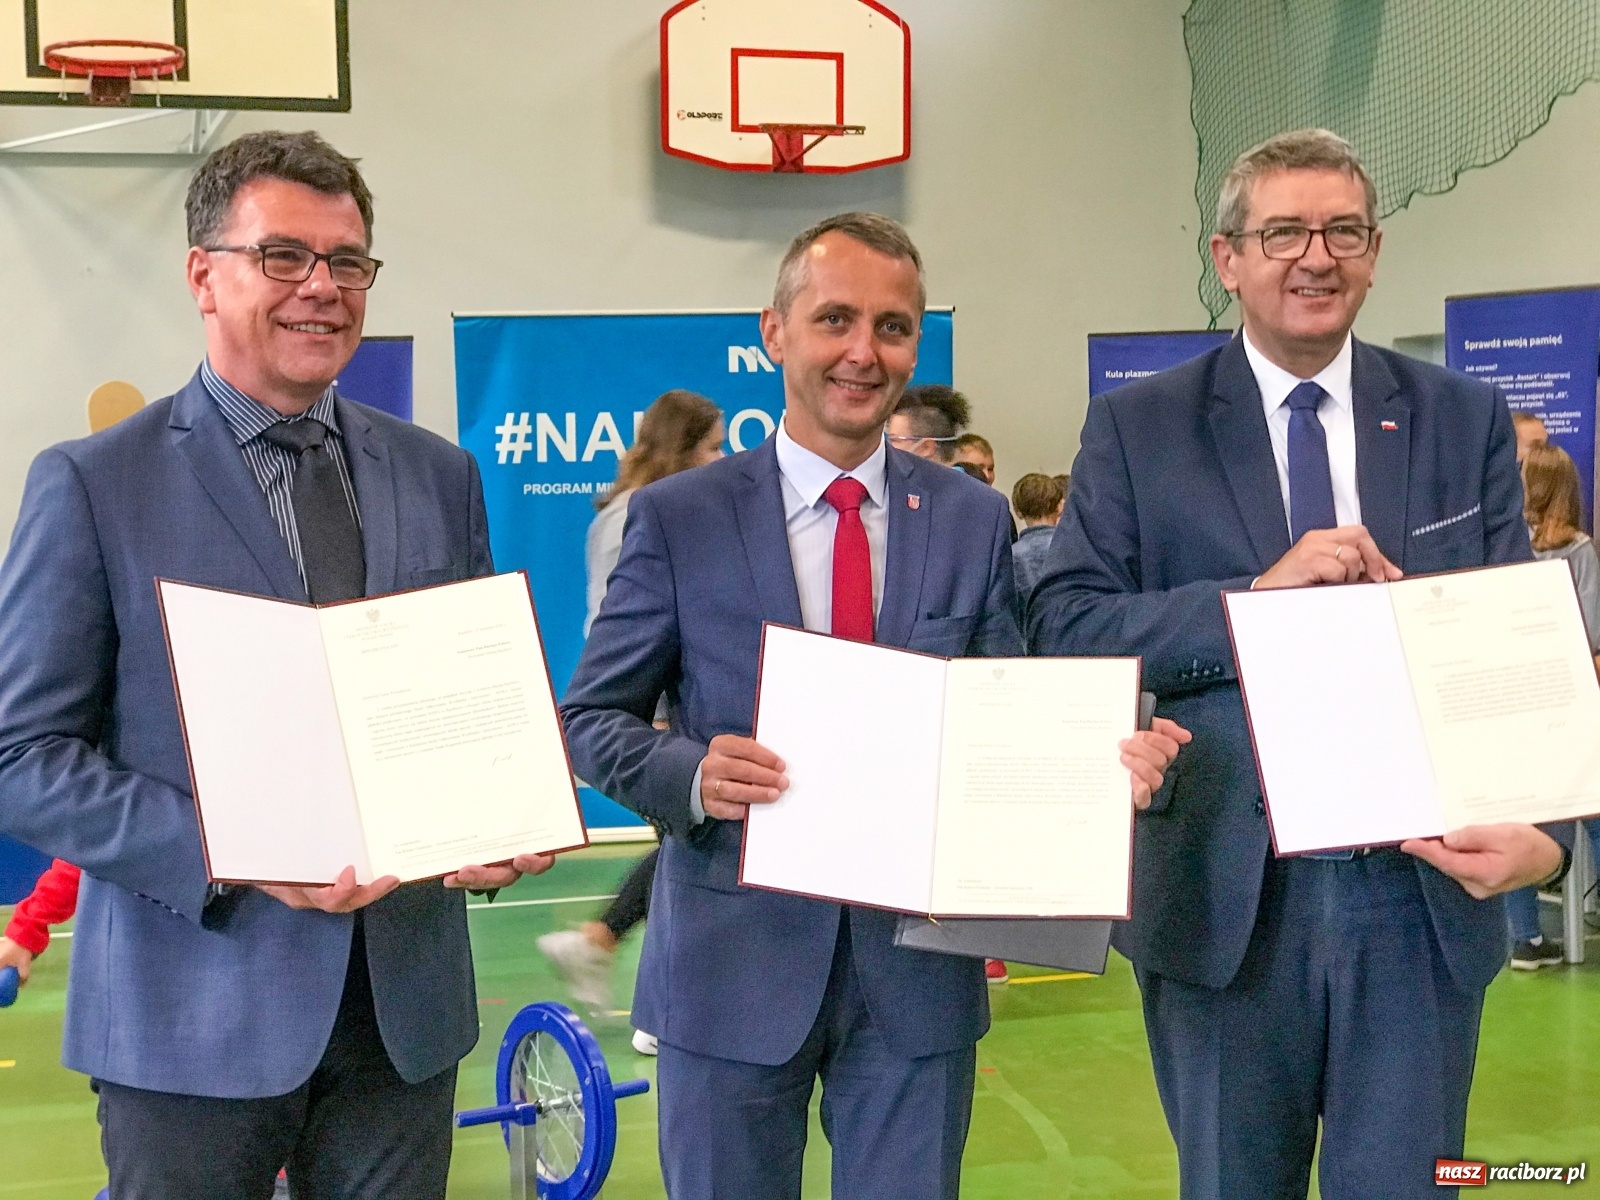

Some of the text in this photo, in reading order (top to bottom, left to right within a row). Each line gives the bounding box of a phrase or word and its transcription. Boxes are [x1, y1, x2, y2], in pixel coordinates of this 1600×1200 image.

[1502, 336, 1528, 348] swoją
[1529, 333, 1562, 347] pamięć
[1105, 370, 1123, 378] Kula
[523, 483, 592, 495] PROGRAM
